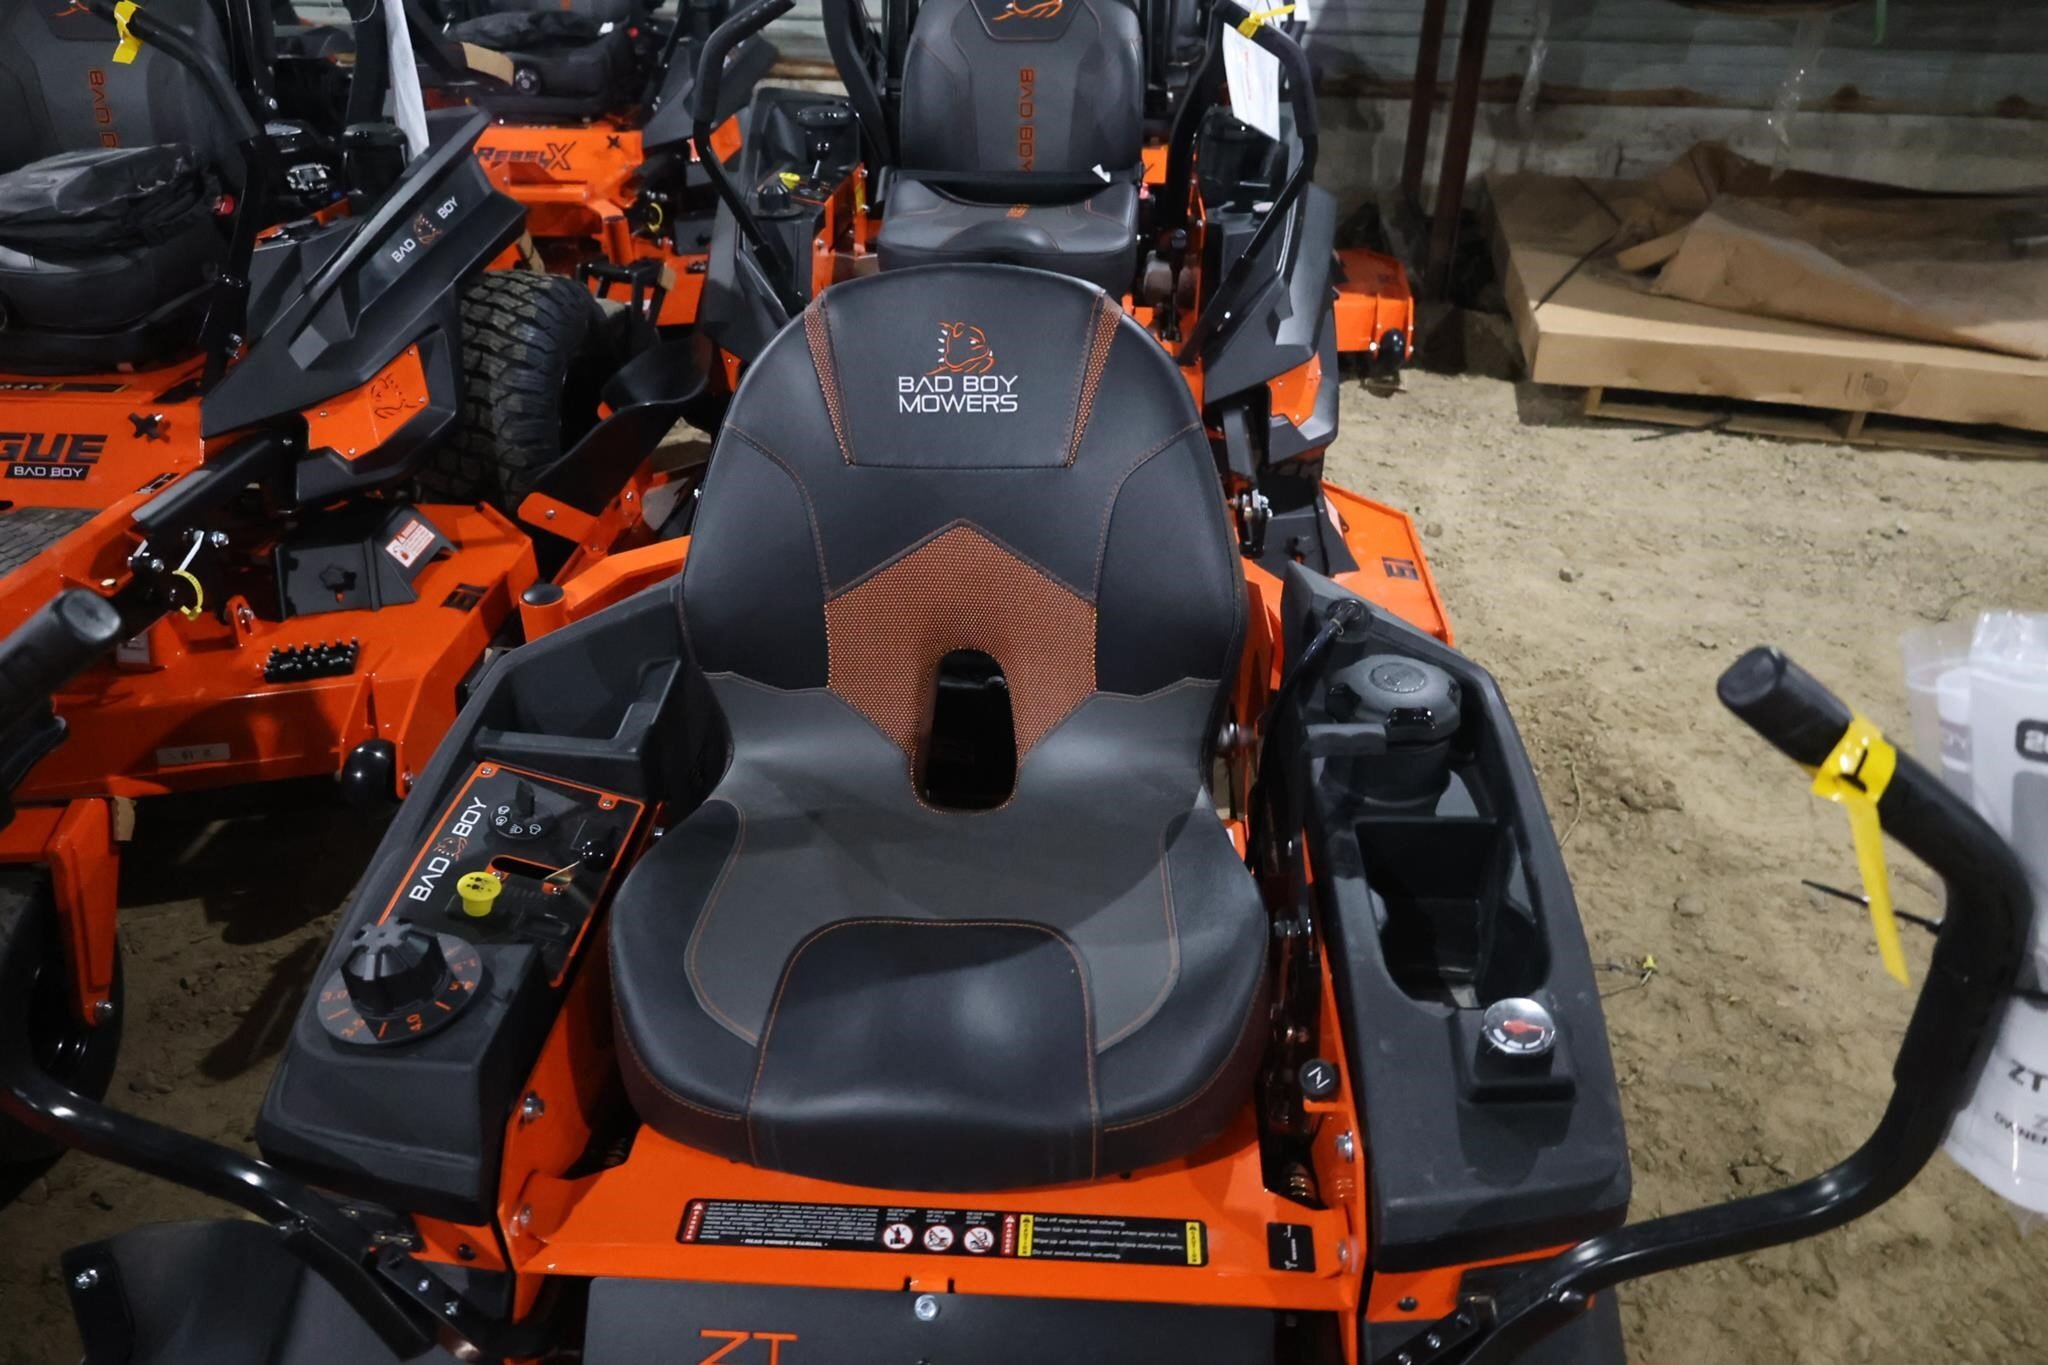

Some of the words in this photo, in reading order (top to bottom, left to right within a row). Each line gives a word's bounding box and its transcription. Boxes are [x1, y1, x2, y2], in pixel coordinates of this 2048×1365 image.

[1019, 68, 1035, 118] BAD
[391, 238, 417, 263] BAD
[437, 195, 458, 219] BOY
[898, 375, 953, 394] BAD
[963, 375, 1018, 393] BOY
[899, 393, 1019, 414] MOWERS
[13, 465, 47, 477] BAD
[49, 466, 84, 478] BOY
[408, 856, 450, 902] BAD
[451, 796, 487, 838] BOY
[699, 1328, 799, 1365] ZT
